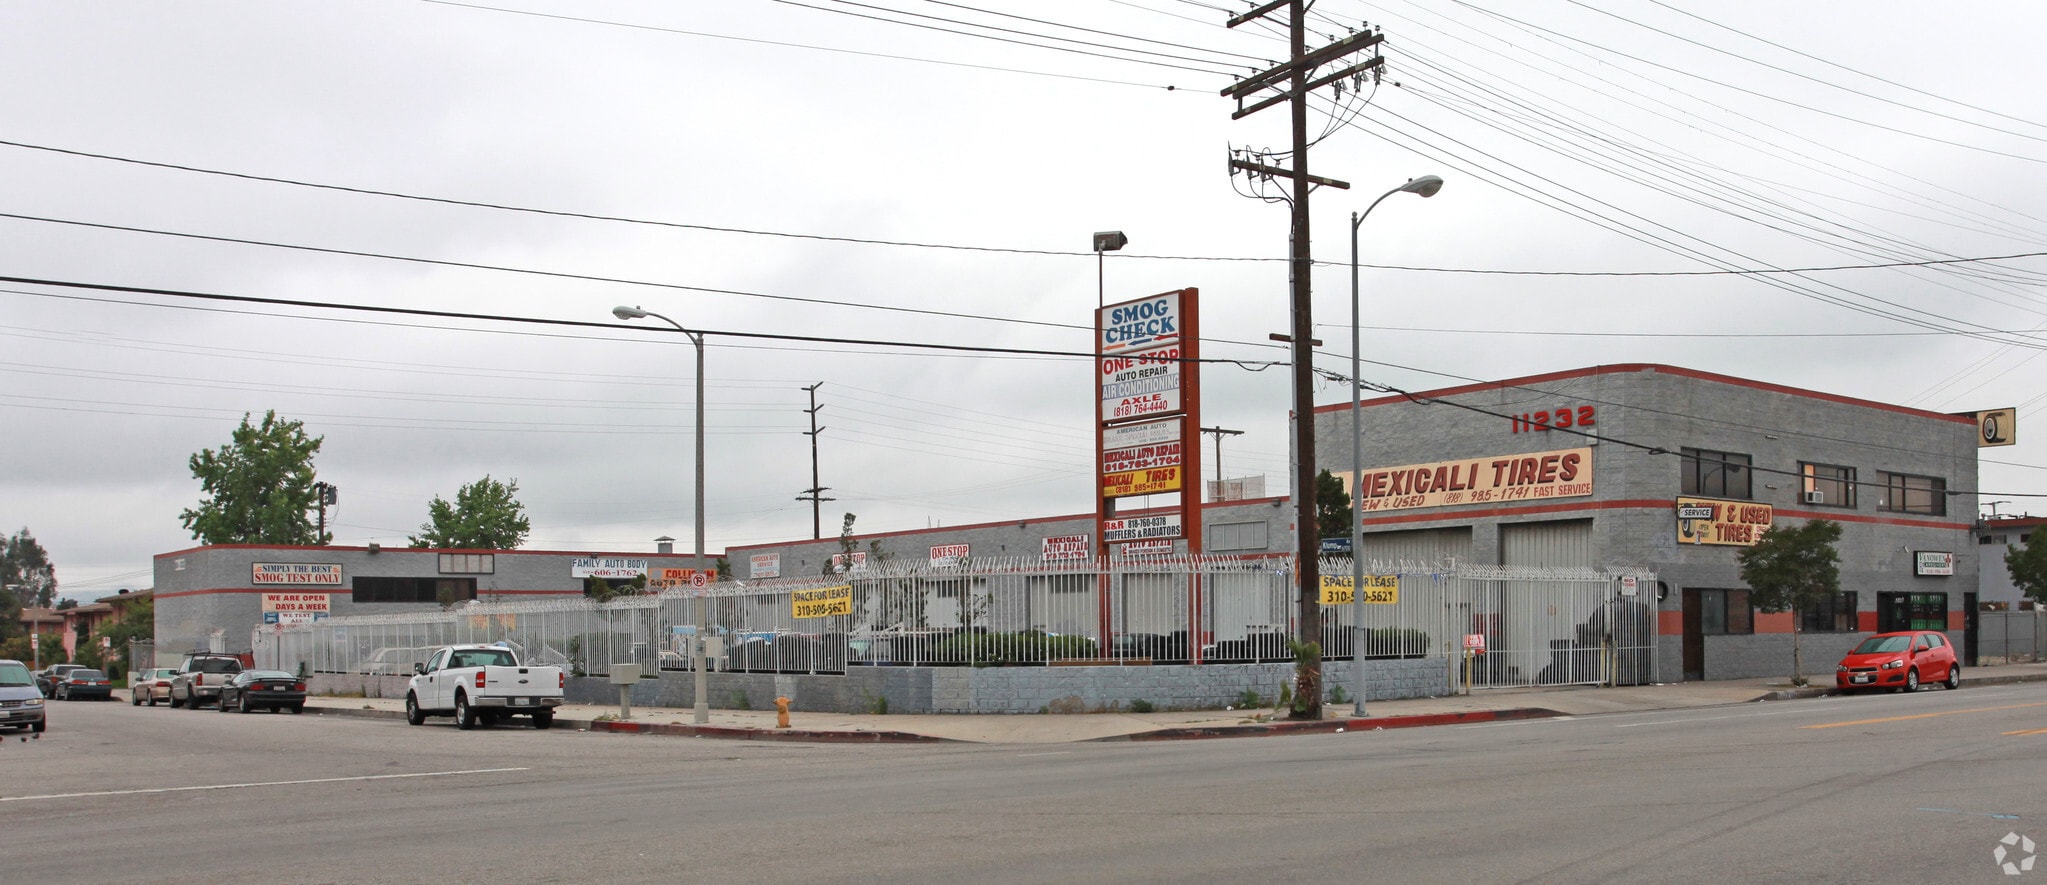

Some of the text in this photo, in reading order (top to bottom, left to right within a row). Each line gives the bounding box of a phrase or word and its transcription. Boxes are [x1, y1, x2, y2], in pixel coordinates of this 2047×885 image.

[1112, 299, 1168, 325] SMOG
[1105, 316, 1175, 343] CHECK
[1103, 349, 1179, 375] ONE STOP
[1115, 366, 1168, 382] AUTO REPAIR
[1102, 375, 1179, 400] AIR CONDITIONING
[1121, 393, 1161, 406] AXLE
[1113, 400, 1168, 417] (818) 764-4440
[1512, 405, 1595, 433] 11232
[1117, 426, 1147, 434] AMERICAN
[1104, 443, 1180, 463] MEXICALI AUTO REPAIR
[1146, 468, 1176, 483] TIRES
[1351, 453, 1581, 499] MEXICALI TIRES
[1361, 499, 1381, 510] EW
[1393, 495, 1425, 508] USED
[1444, 492, 1464, 504] (818)
[1533, 486, 1554, 497] FAST
[1558, 483, 1591, 496] SERVICE
[1727, 504, 1737, 522] &
[1740, 505, 1770, 525] USED
[1104, 520, 1124, 531] R&R
[1104, 525, 1181, 541] MUFFLERS & RADIATORS
[1715, 523, 1752, 542] TIRES
[1044, 542, 1088, 553] AUTO REPAIR
[1047, 536, 1084, 545] MEXICALI
[850, 554, 865, 564] TOP
[932, 545, 968, 559] ONE STOP
[263, 565, 291, 573] SIMPLY
[293, 565, 310, 573] THE
[572, 559, 648, 568] FAMILY AUTO BODY
[255, 573, 340, 583] SMOG TEST ONLY
[1324, 577, 1352, 587] SPACE
[1371, 577, 1395, 587] LEASE
[794, 588, 850, 602] SPACE FOR LEASE
